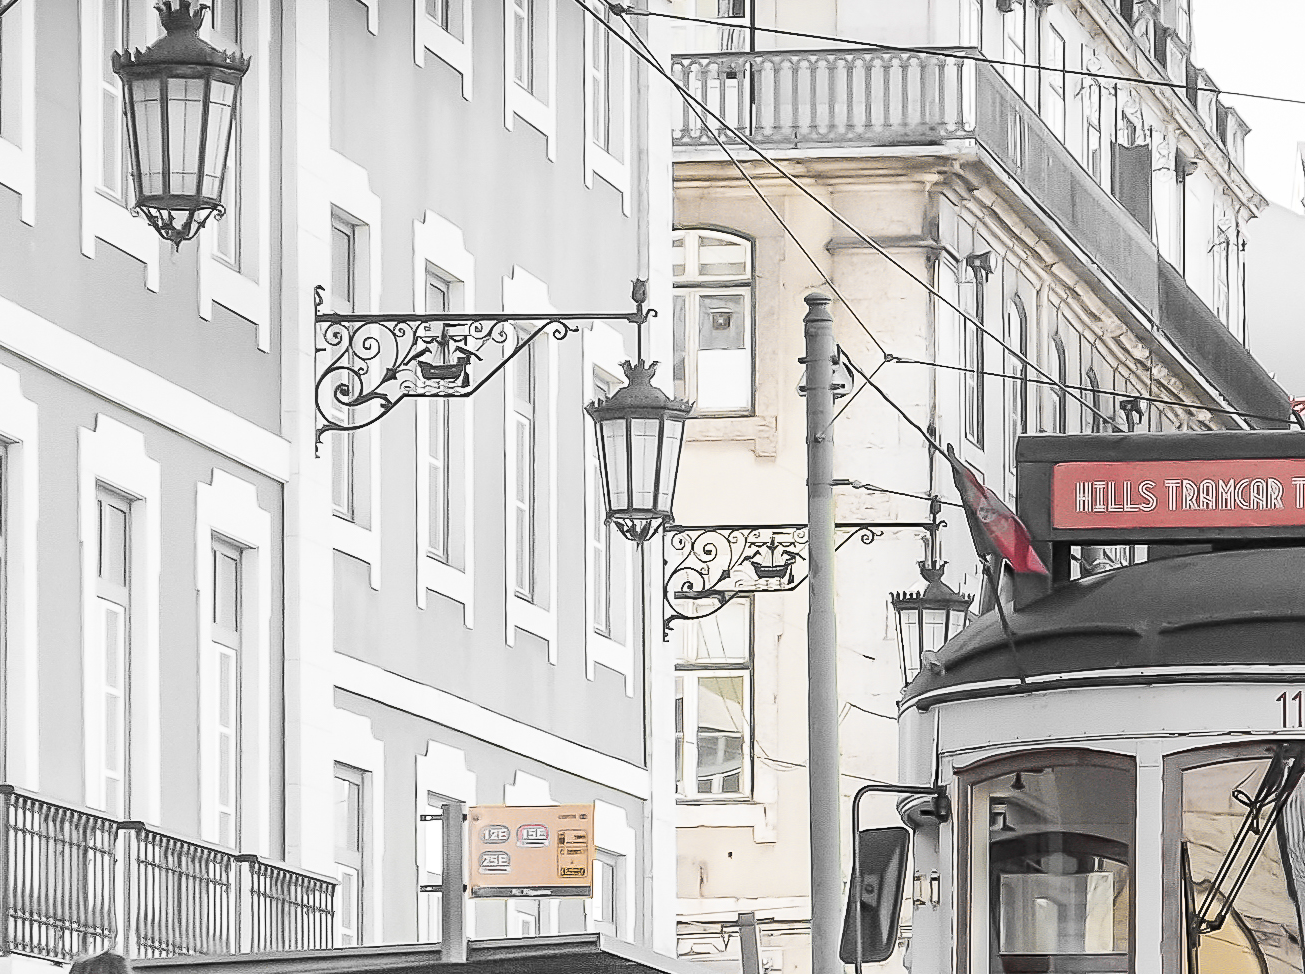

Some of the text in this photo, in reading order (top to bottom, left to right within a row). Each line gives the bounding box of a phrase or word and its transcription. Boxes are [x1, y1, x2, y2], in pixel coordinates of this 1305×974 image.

[1075, 480, 1157, 513] HILLS
[1164, 478, 1285, 512] TRAMCAR
[1275, 690, 1303, 729] 11
